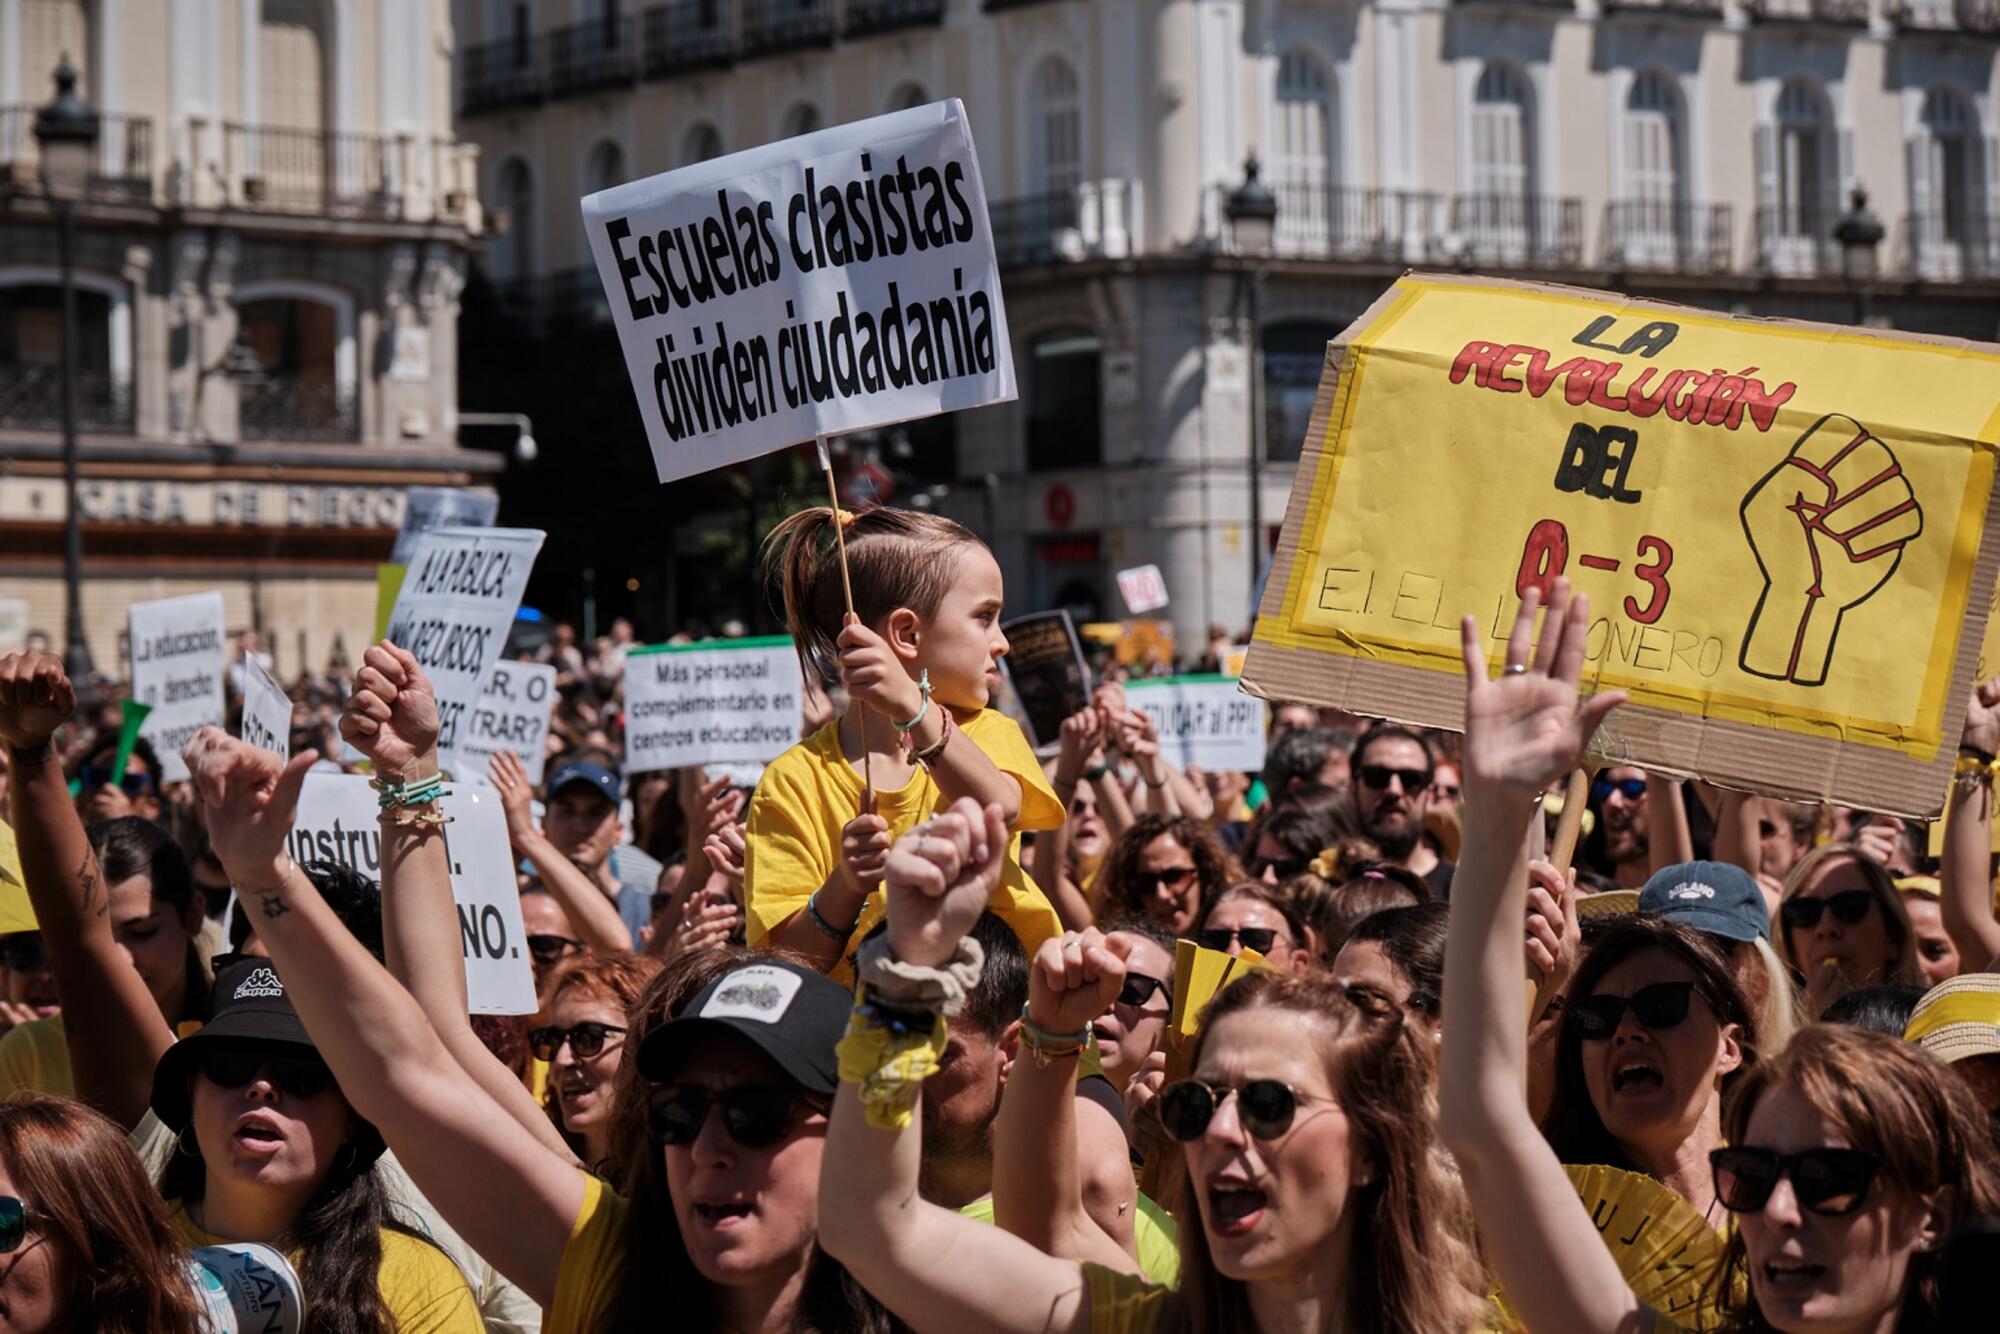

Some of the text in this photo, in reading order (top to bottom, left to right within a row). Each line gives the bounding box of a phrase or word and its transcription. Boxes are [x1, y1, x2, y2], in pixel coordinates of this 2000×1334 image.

[605, 153, 974, 321] Escuelas clasistas
[653, 267, 996, 443] dividen ciudadanía
[1572, 315, 1680, 358] LA
[1449, 341, 1797, 432] REVOLUCIÓN
[1554, 422, 1642, 503] DEL
[1392, 571, 1464, 630] EL
[1491, 594, 1723, 678] LONERO
[631, 690, 794, 720] complementario en
[656, 658, 770, 684] Más personal
[633, 722, 792, 751] centros educativos
